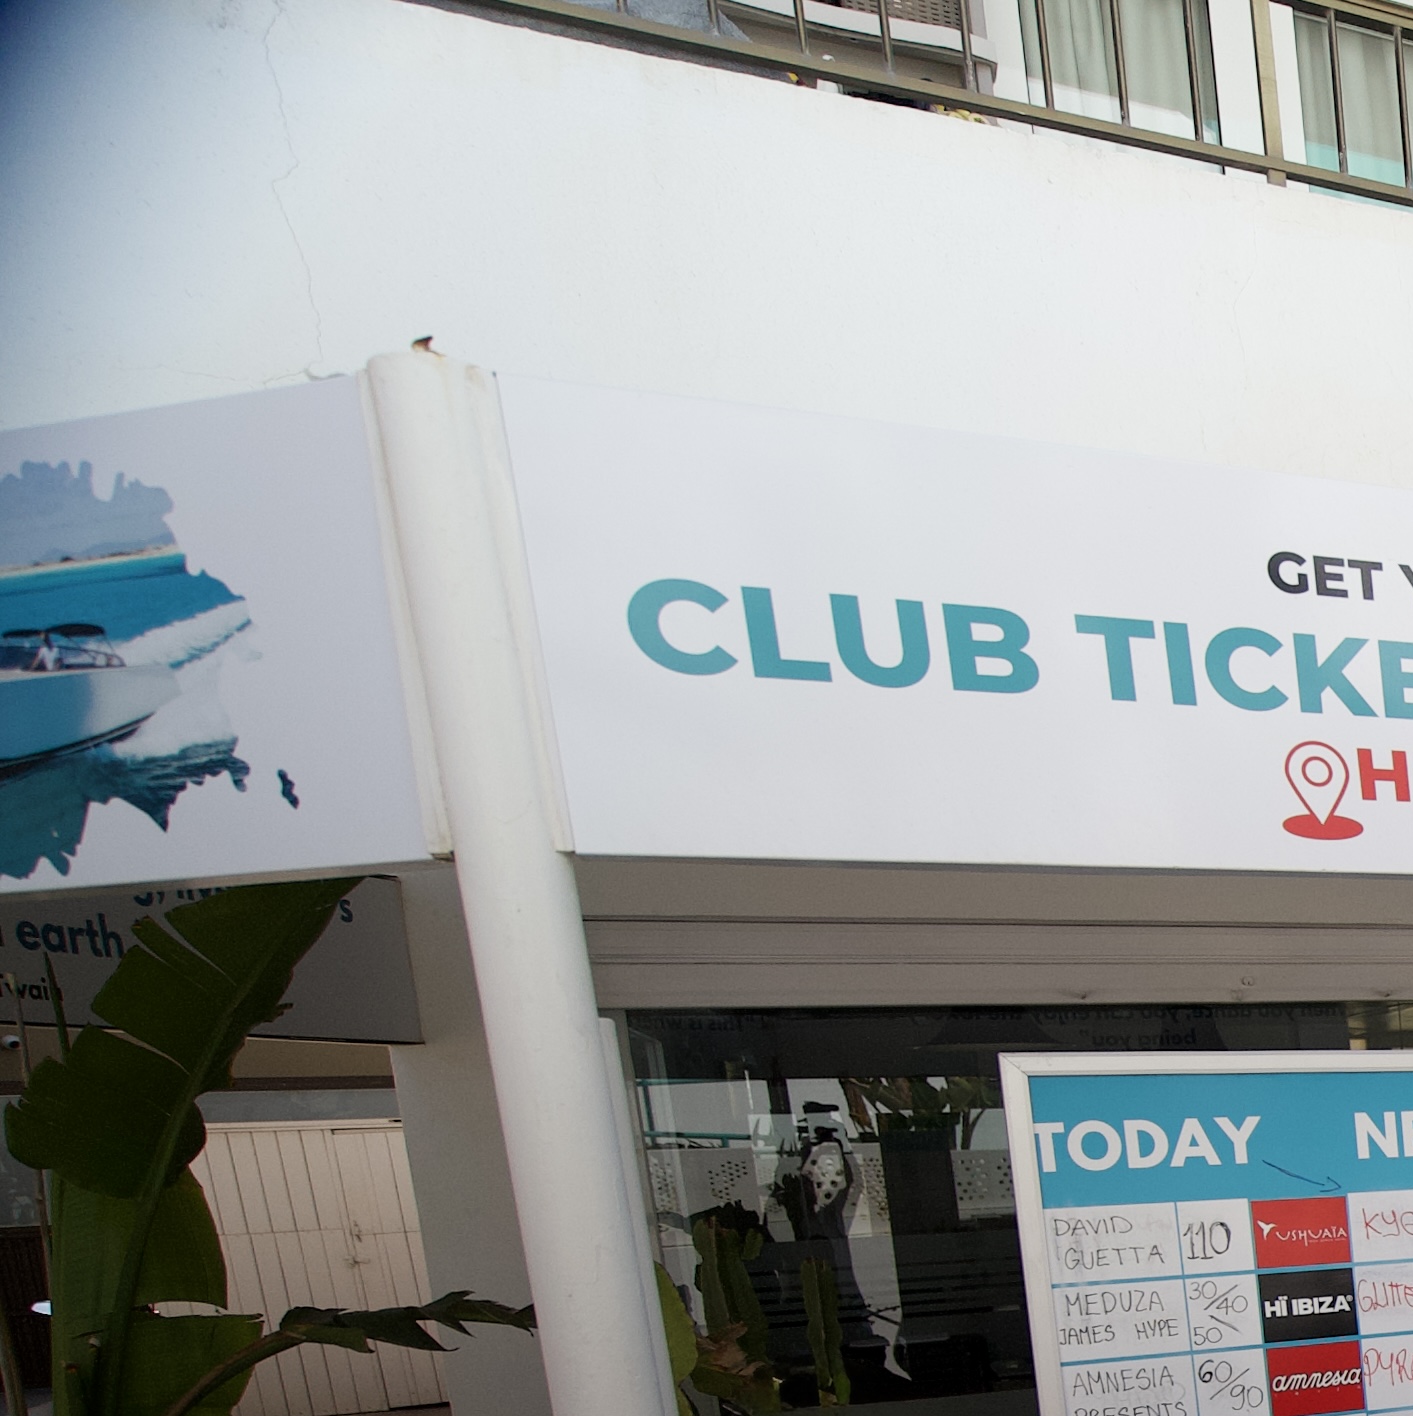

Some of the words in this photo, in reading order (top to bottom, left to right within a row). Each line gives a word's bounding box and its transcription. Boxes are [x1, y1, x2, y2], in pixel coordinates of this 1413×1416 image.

[1267, 550, 1382, 601] GET
[627, 577, 1040, 696] CLUB
[16, 914, 124, 958] earth
[1033, 1116, 1261, 1173] TODAY
[1053, 1216, 1132, 1237] DAVID
[1183, 1221, 1231, 1260] 110
[1064, 1244, 1165, 1270] GUETTA
[1065, 1290, 1164, 1316] MEDUZA
[1059, 1325, 1116, 1346] JAMES
[1134, 1318, 1180, 1340] HYPE
[1072, 1366, 1174, 1397] AMNESIA
[1272, 1367, 1361, 1393] amnesia
